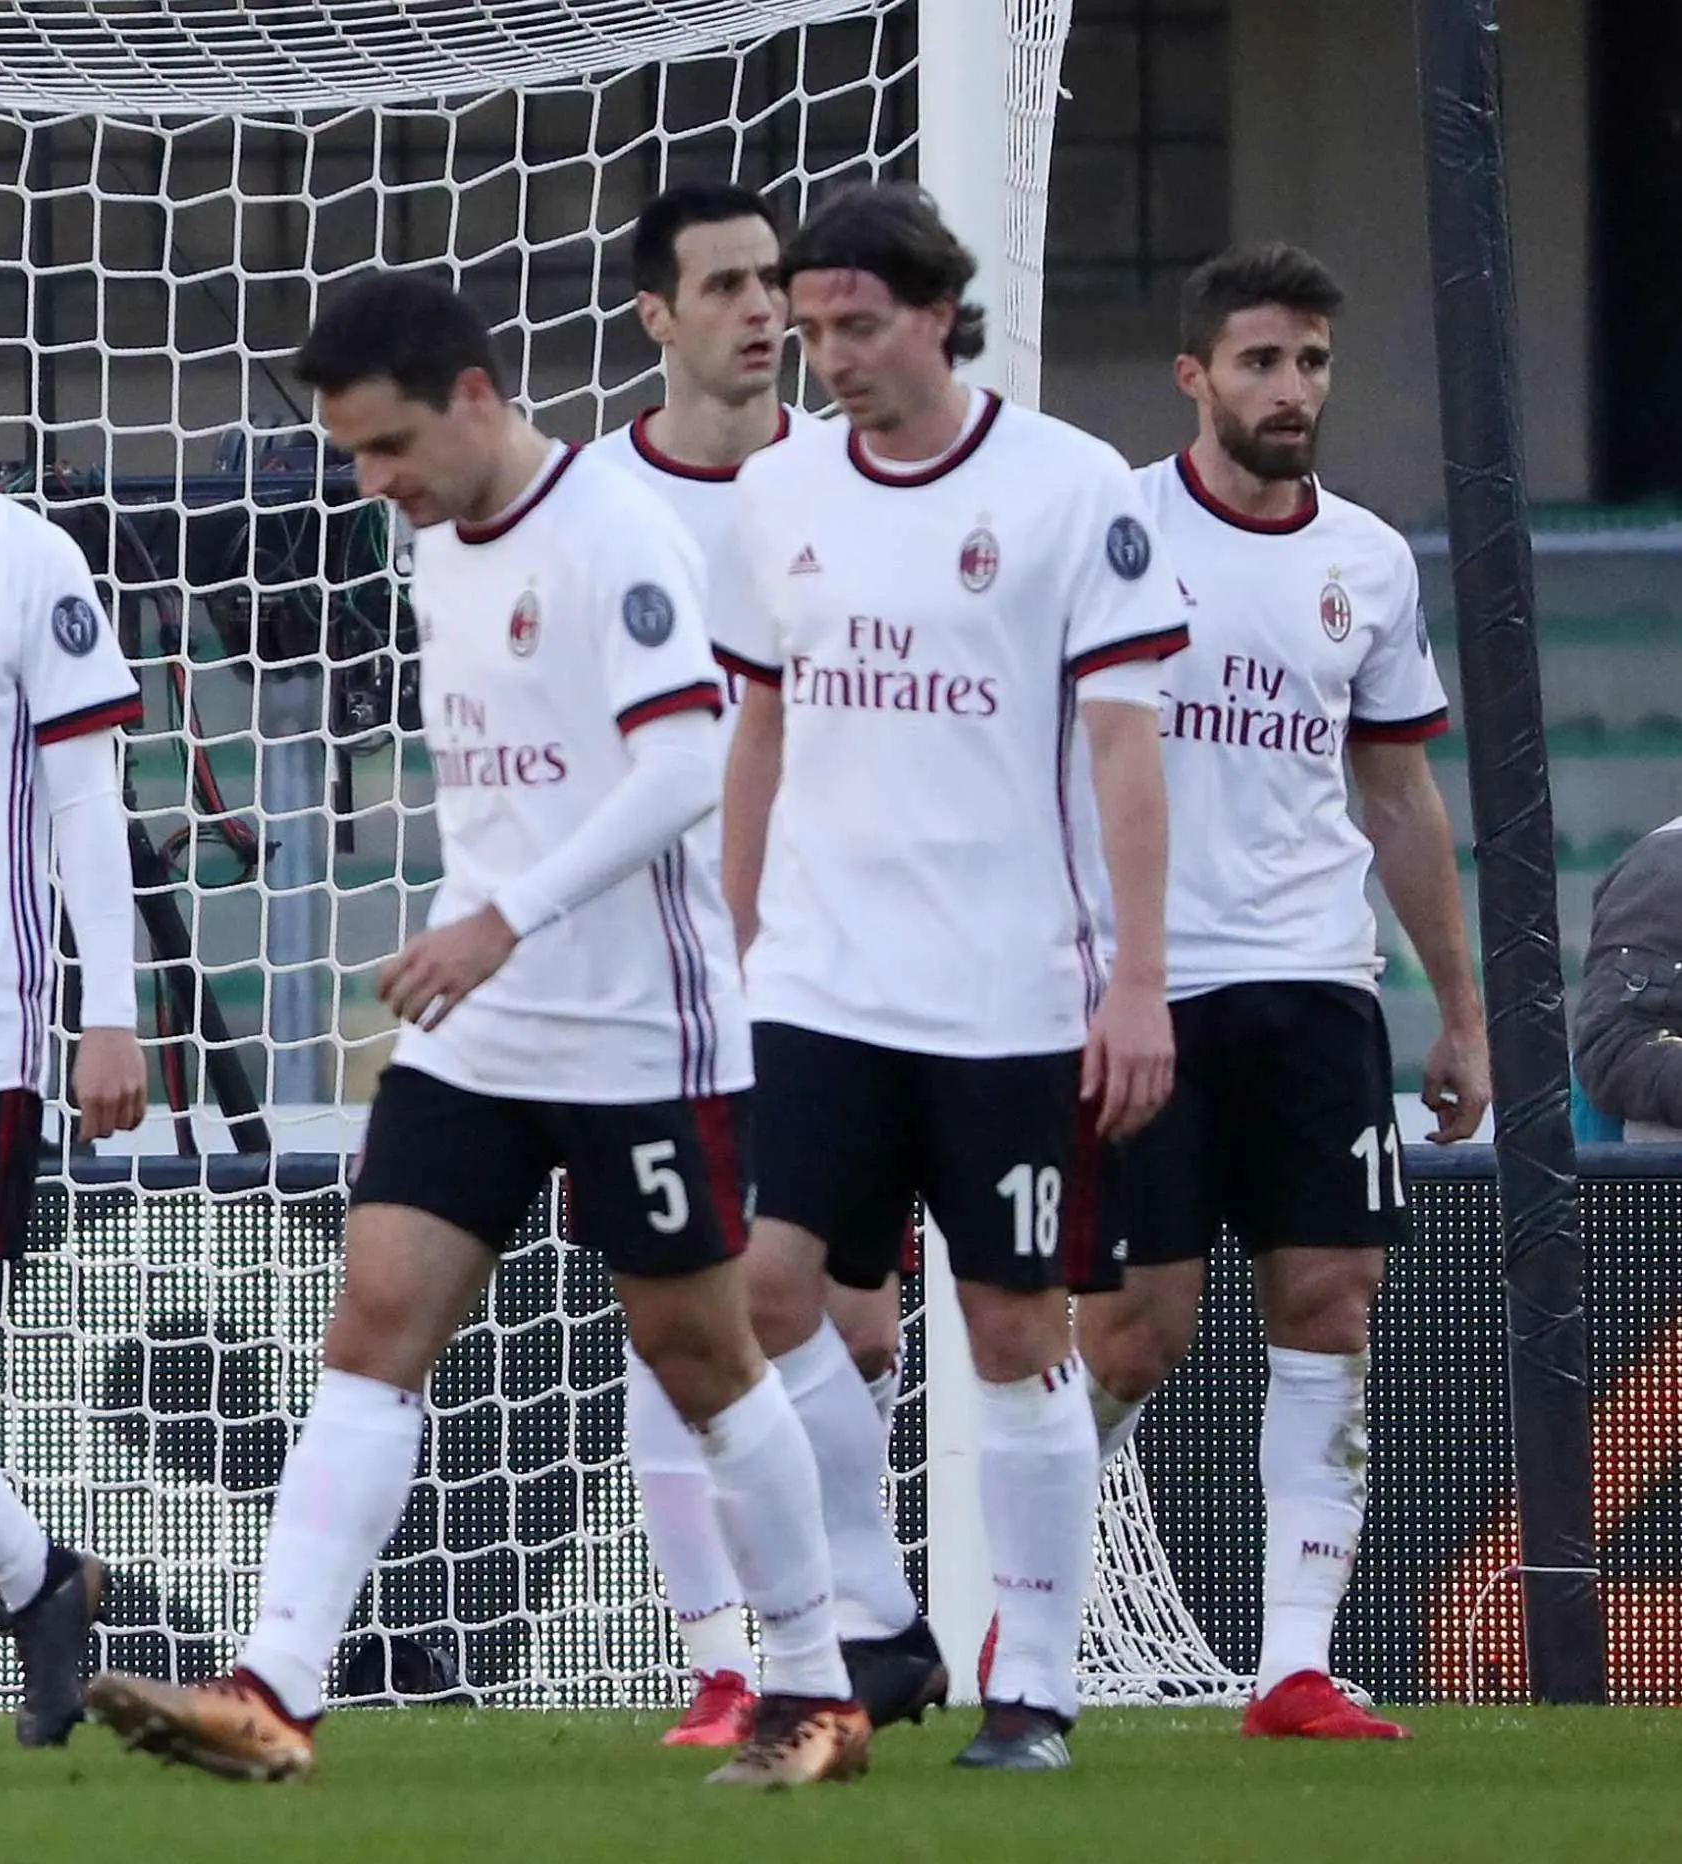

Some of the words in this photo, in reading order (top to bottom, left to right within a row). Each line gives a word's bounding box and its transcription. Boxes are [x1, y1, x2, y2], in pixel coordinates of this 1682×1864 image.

[849, 615, 913, 660] Fly
[1222, 654, 1285, 701] Fly
[630, 1138, 690, 1234] 5
[1350, 1121, 1407, 1212] 11
[995, 1162, 1062, 1258] 18
[1301, 1540, 1355, 1561] MIL
